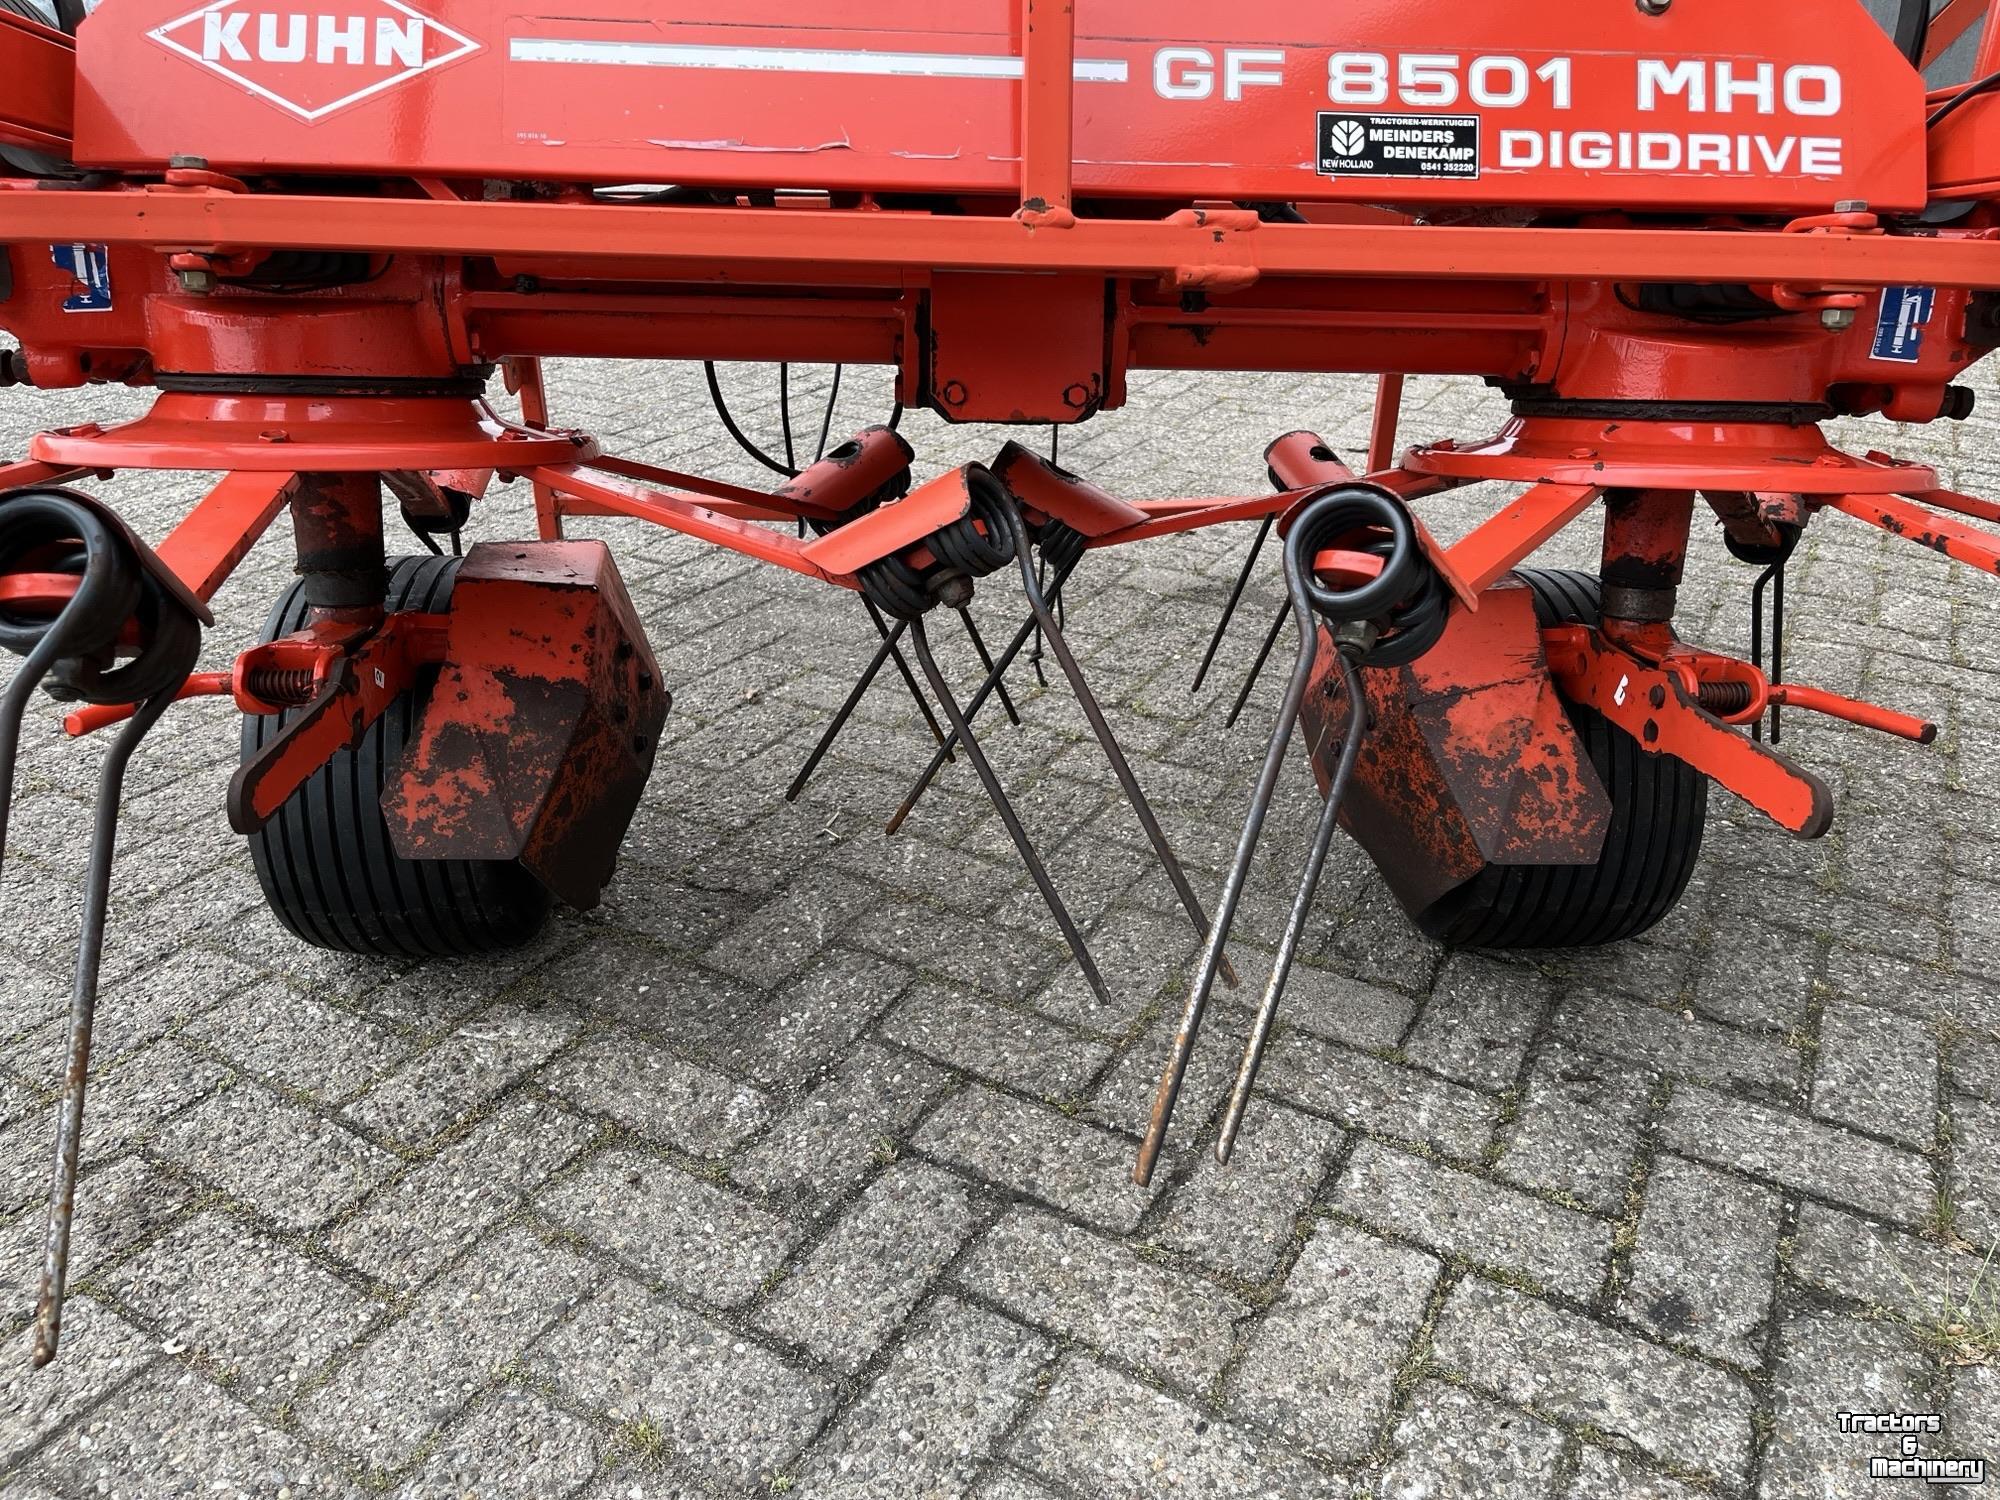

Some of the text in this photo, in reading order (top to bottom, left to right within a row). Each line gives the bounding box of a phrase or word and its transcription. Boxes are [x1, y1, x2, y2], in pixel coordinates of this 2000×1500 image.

[202, 11, 424, 68] KUHN
[1153, 47, 1841, 116] GF 8501 MHO
[1370, 117, 1475, 127] TRACTOREN-WERKTUIGEN
[1369, 129, 1455, 143] MEINDERS
[1383, 146, 1474, 160] DENEKAMP
[1499, 129, 1842, 174] DIGIDRIVE
[1322, 159, 1373, 169] NEW HOLLAND
[1421, 162, 1474, 172] 0541 352220
